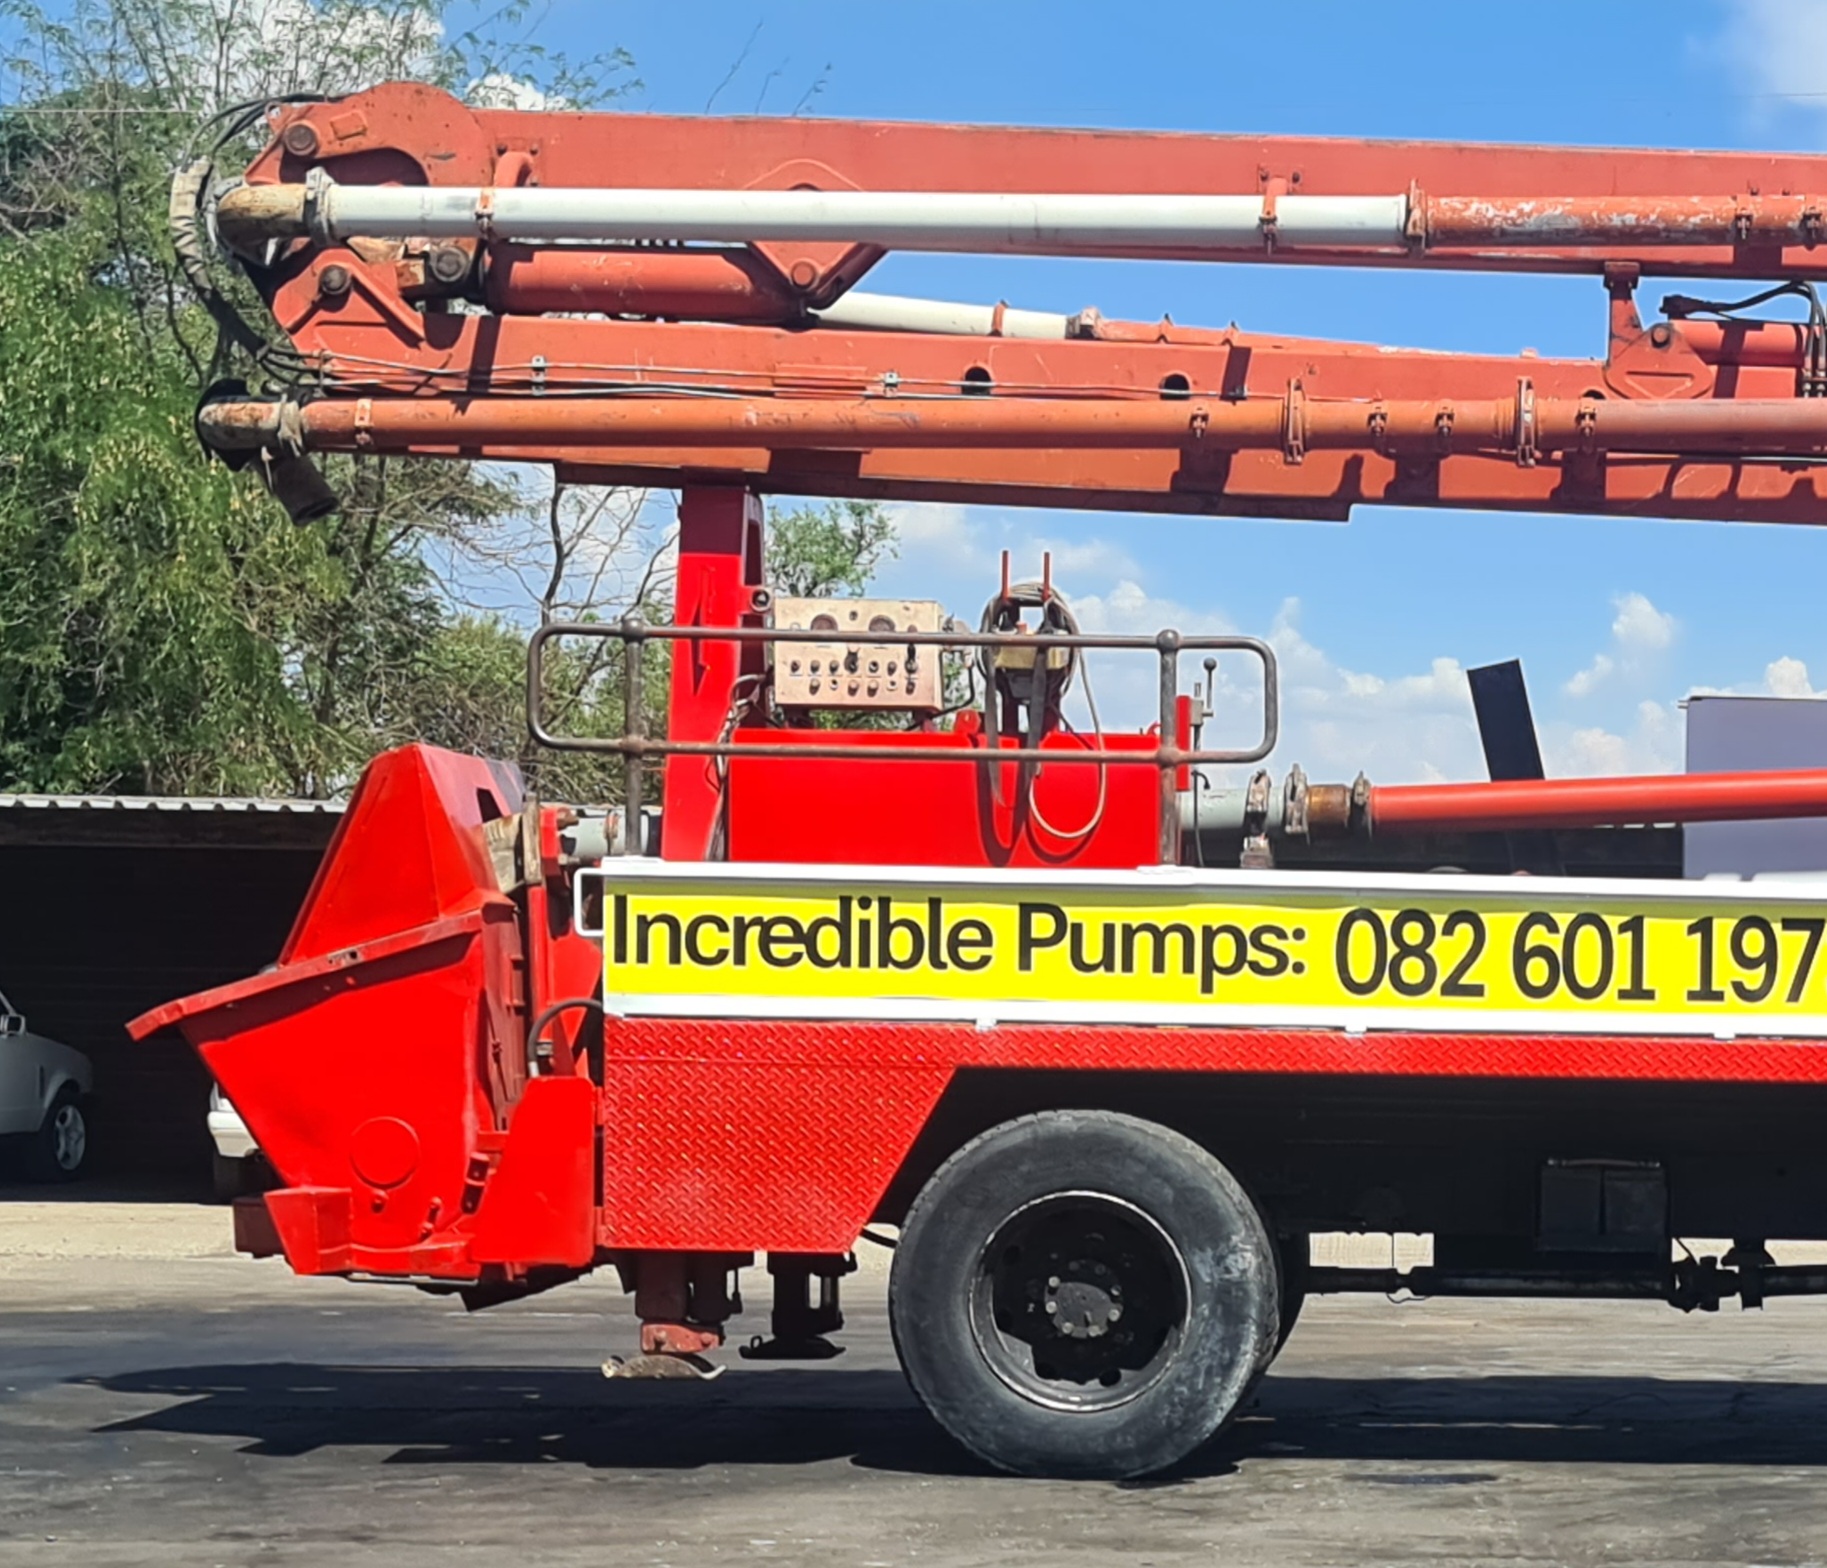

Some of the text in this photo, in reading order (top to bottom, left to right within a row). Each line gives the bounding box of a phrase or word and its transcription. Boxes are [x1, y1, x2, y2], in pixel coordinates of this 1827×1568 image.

[612, 893, 994, 972] Incredible
[1018, 900, 1306, 995] Pumps:
[1335, 906, 1487, 998] 082
[1512, 910, 1656, 1001] 601
